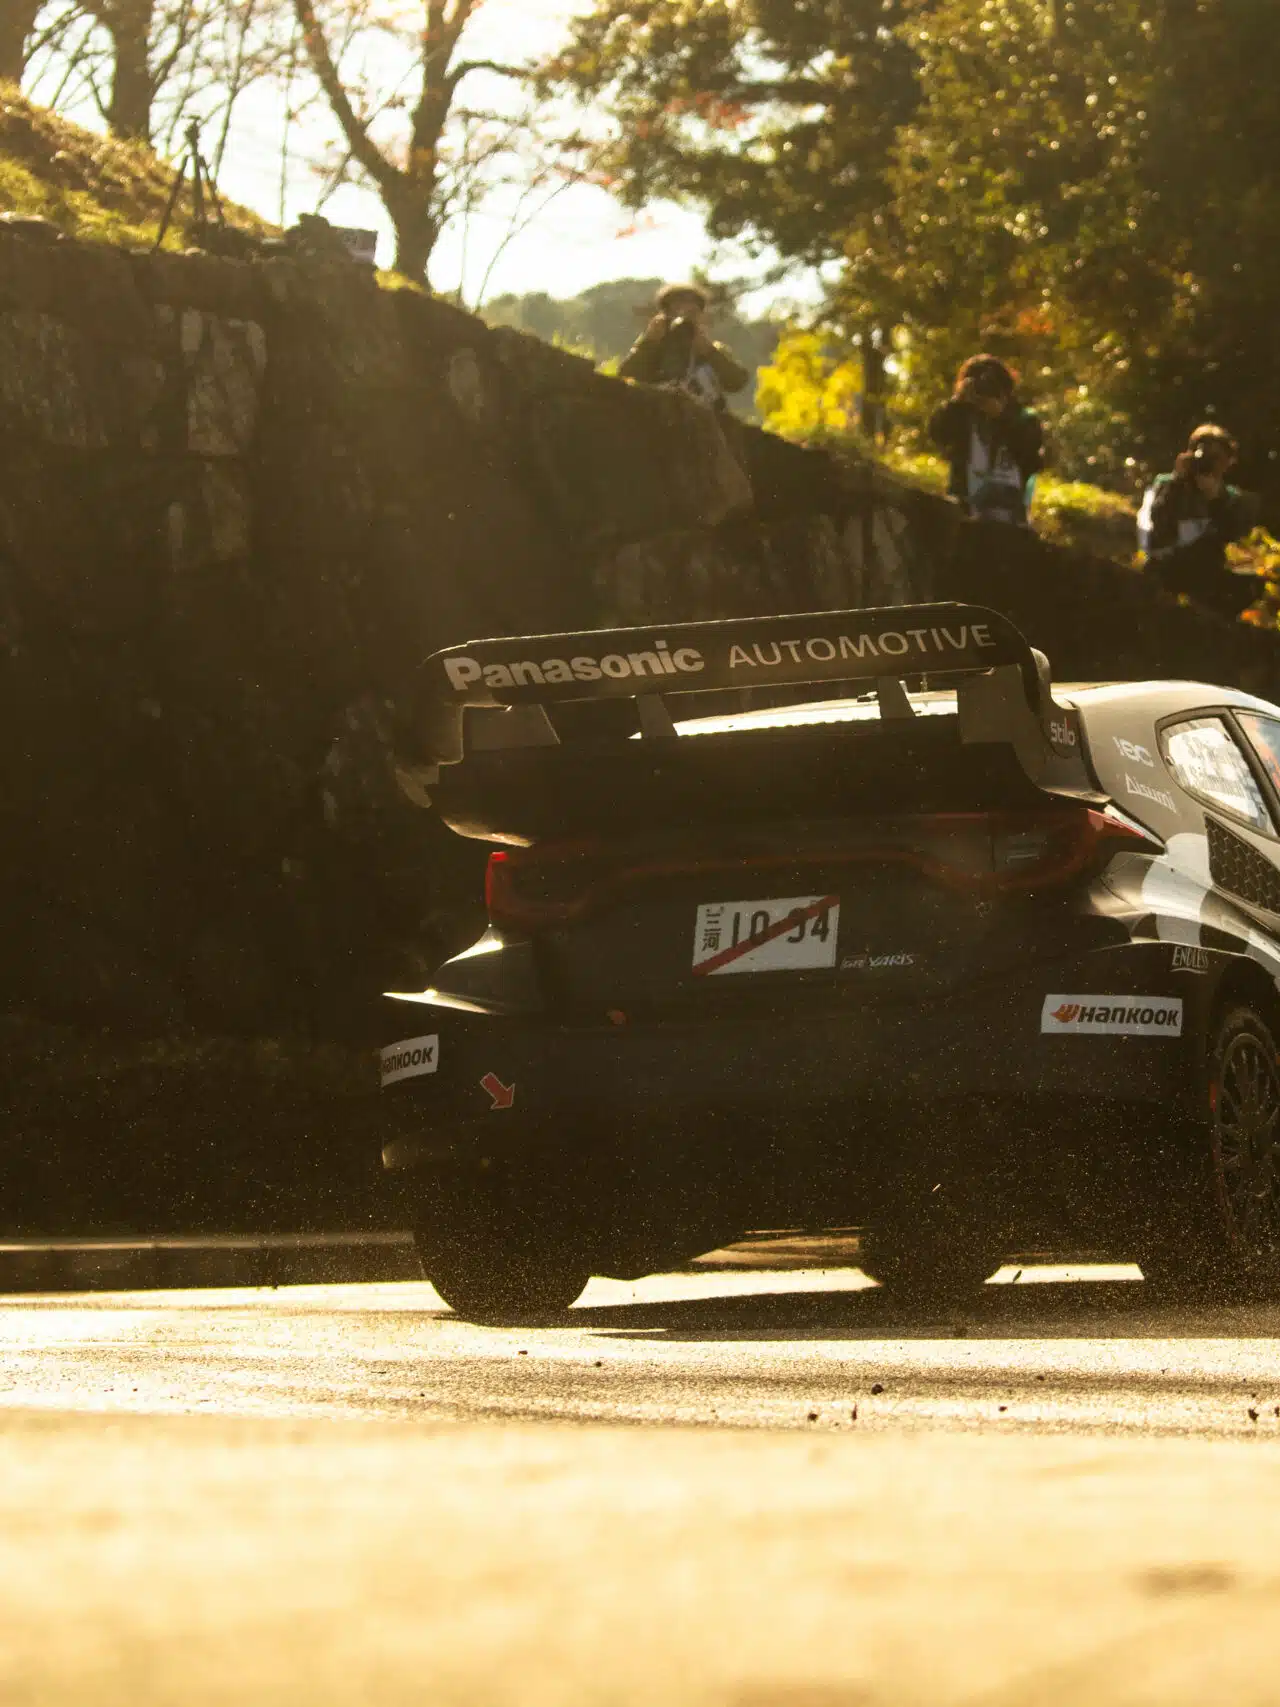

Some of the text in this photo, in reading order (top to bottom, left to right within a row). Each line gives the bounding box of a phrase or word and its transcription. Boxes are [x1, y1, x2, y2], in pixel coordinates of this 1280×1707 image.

[444, 622, 998, 691] Panasonic AUTOMOTIVE
[1171, 946, 1209, 969] ENDLESS
